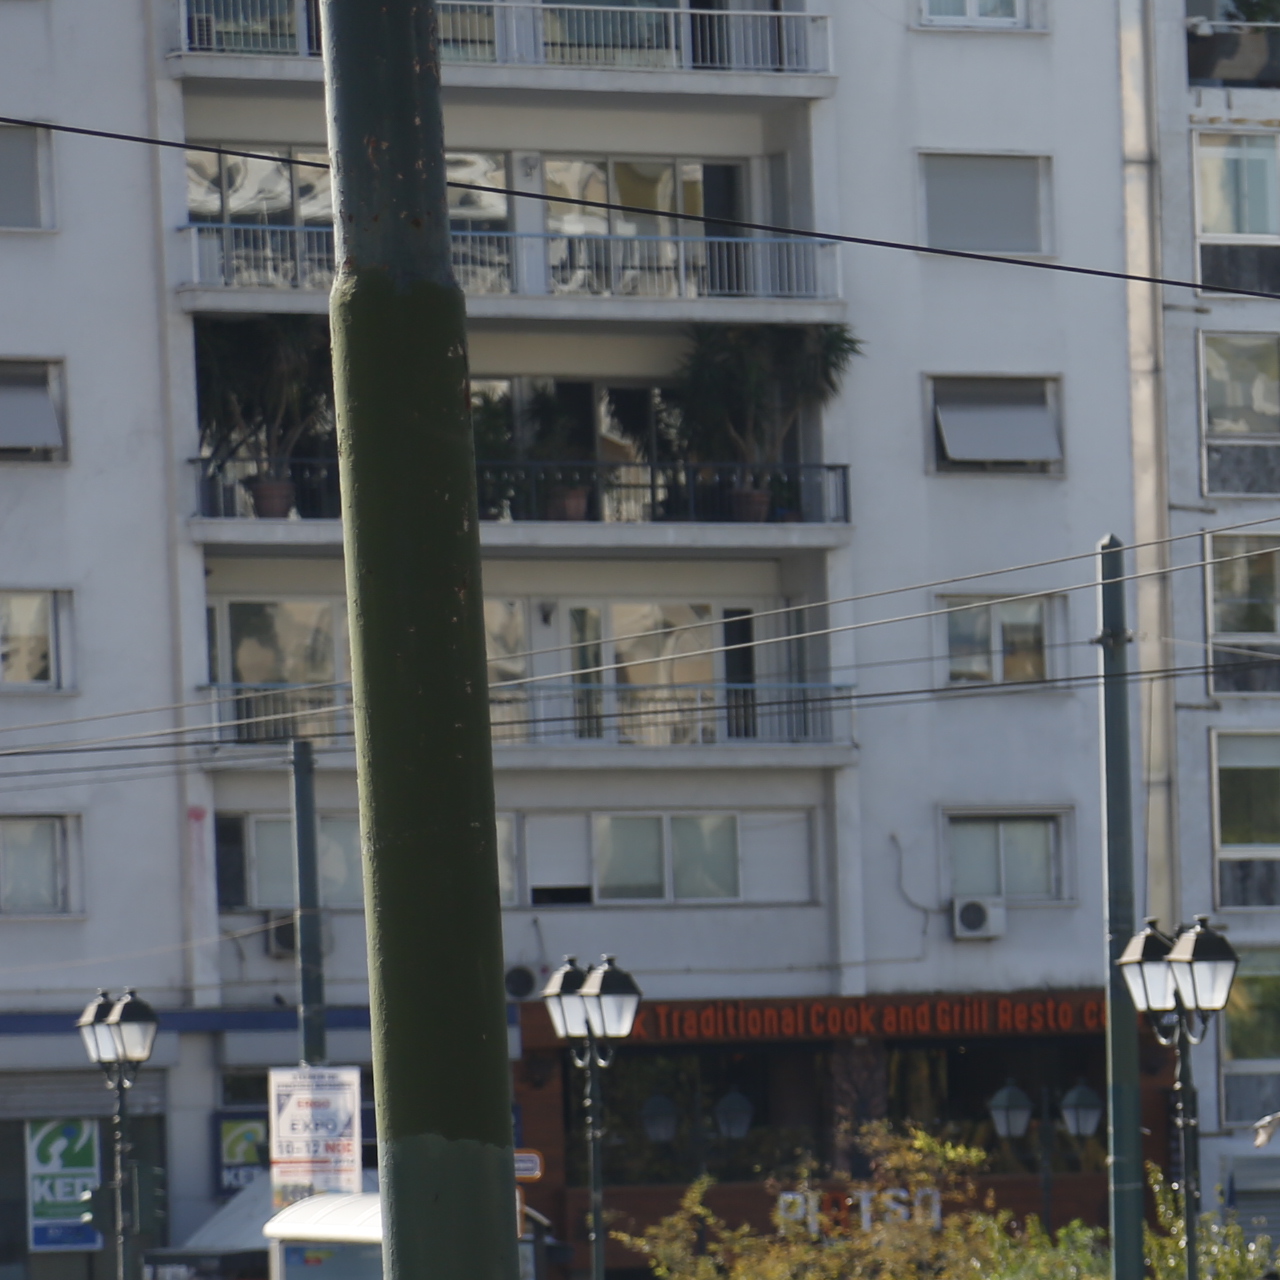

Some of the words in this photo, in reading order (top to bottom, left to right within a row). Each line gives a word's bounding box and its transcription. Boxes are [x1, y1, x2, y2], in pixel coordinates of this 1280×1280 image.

[656, 1003, 804, 1040] Traditional
[811, 1002, 876, 1036] Cook
[883, 1003, 931, 1033] and
[937, 997, 988, 1032] Grill
[998, 998, 1074, 1031] Resto
